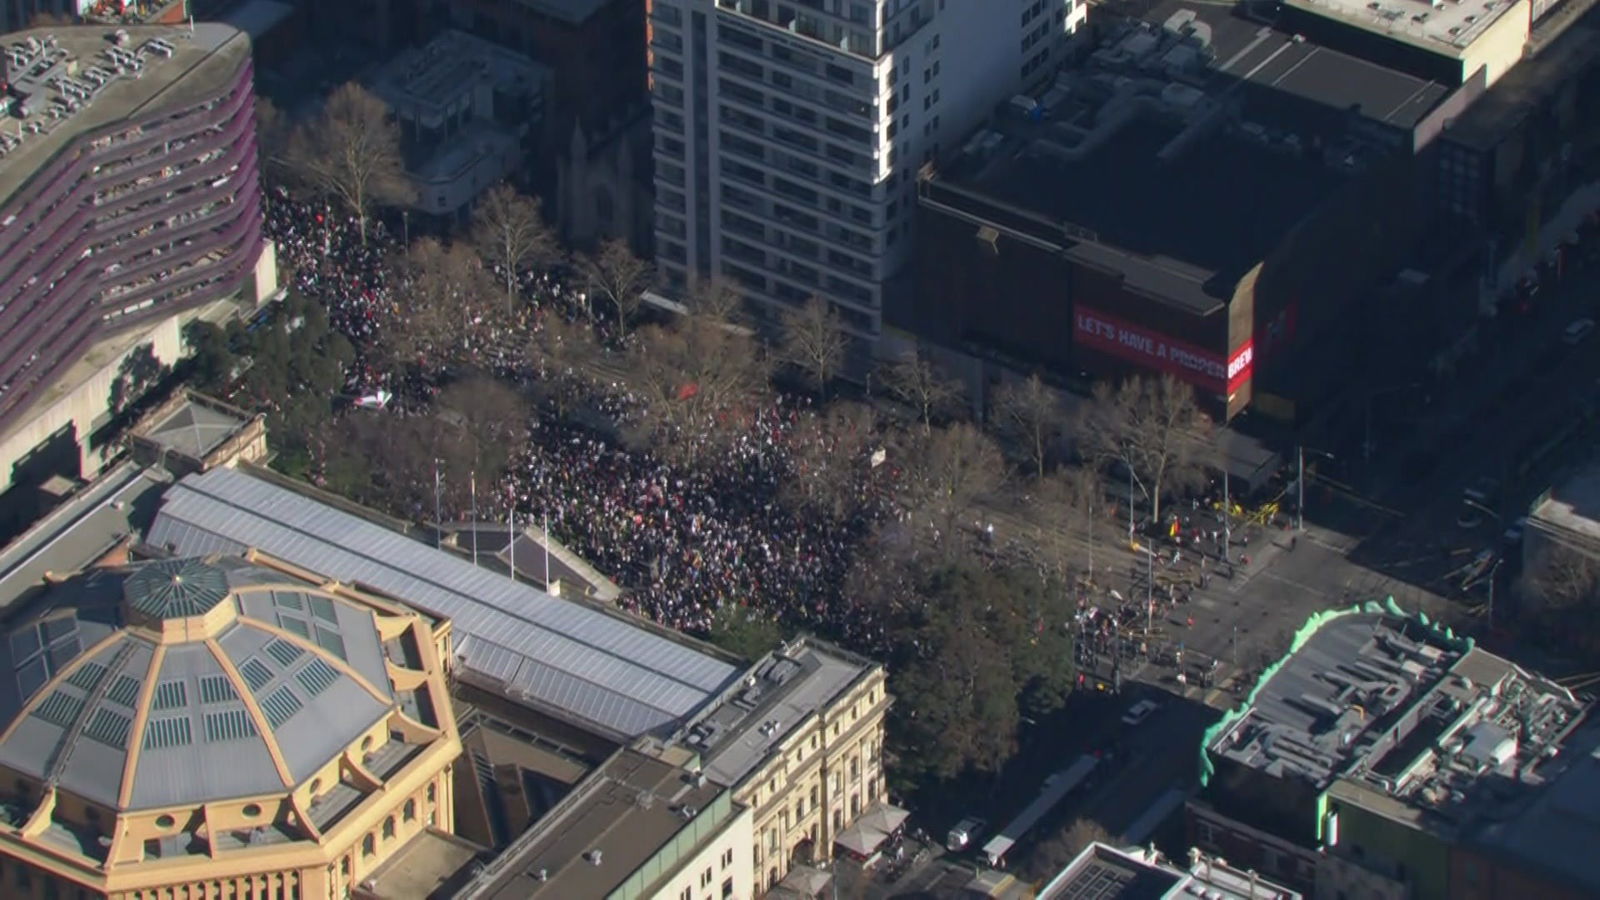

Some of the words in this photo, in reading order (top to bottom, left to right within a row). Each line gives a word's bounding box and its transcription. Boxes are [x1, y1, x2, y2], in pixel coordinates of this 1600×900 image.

[1078, 315, 1115, 340] LET'S
[1119, 329, 1153, 354] HAVE
[1157, 342, 1167, 359] A
[1228, 347, 1253, 379] BREW
